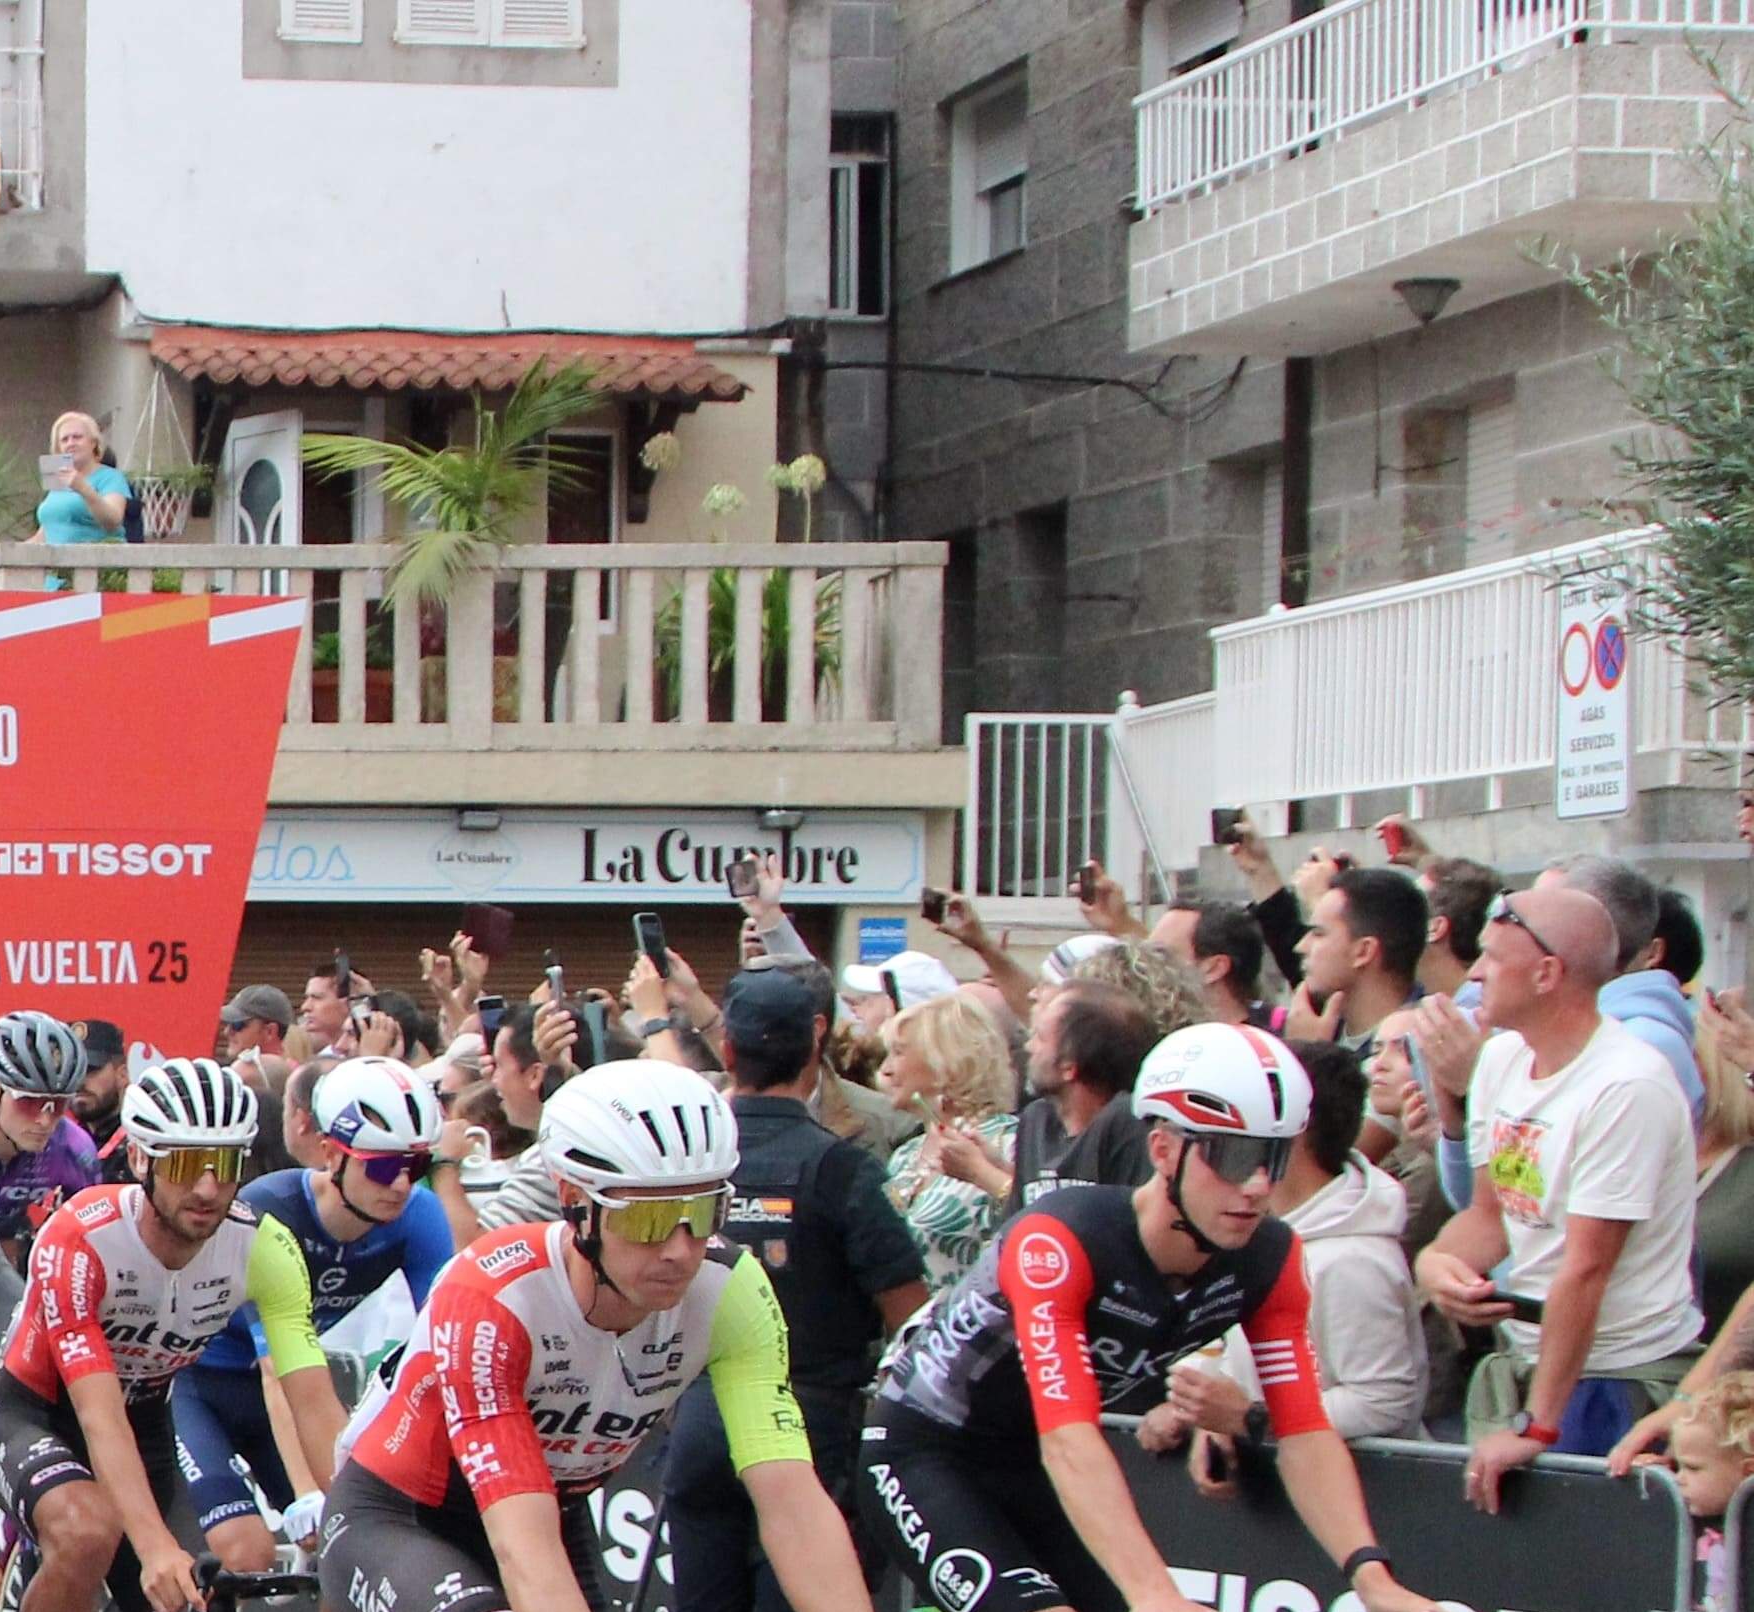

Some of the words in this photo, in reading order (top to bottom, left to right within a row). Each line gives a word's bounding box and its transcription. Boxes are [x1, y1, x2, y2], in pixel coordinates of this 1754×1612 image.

[47, 843, 212, 876] TISSOT
[436, 849, 455, 863] La
[457, 849, 513, 865] Cumbre
[581, 827, 646, 884] La
[6, 940, 138, 985] VUELTA
[147, 940, 189, 984] 25
[610, 1098, 636, 1124] uvex
[1022, 1249, 1061, 1269] B&B
[912, 1289, 1008, 1397] ARKEA
[1027, 1300, 1070, 1401] ARKEA
[867, 1462, 932, 1565] ARKEA
[935, 1561, 977, 1600] B&B
